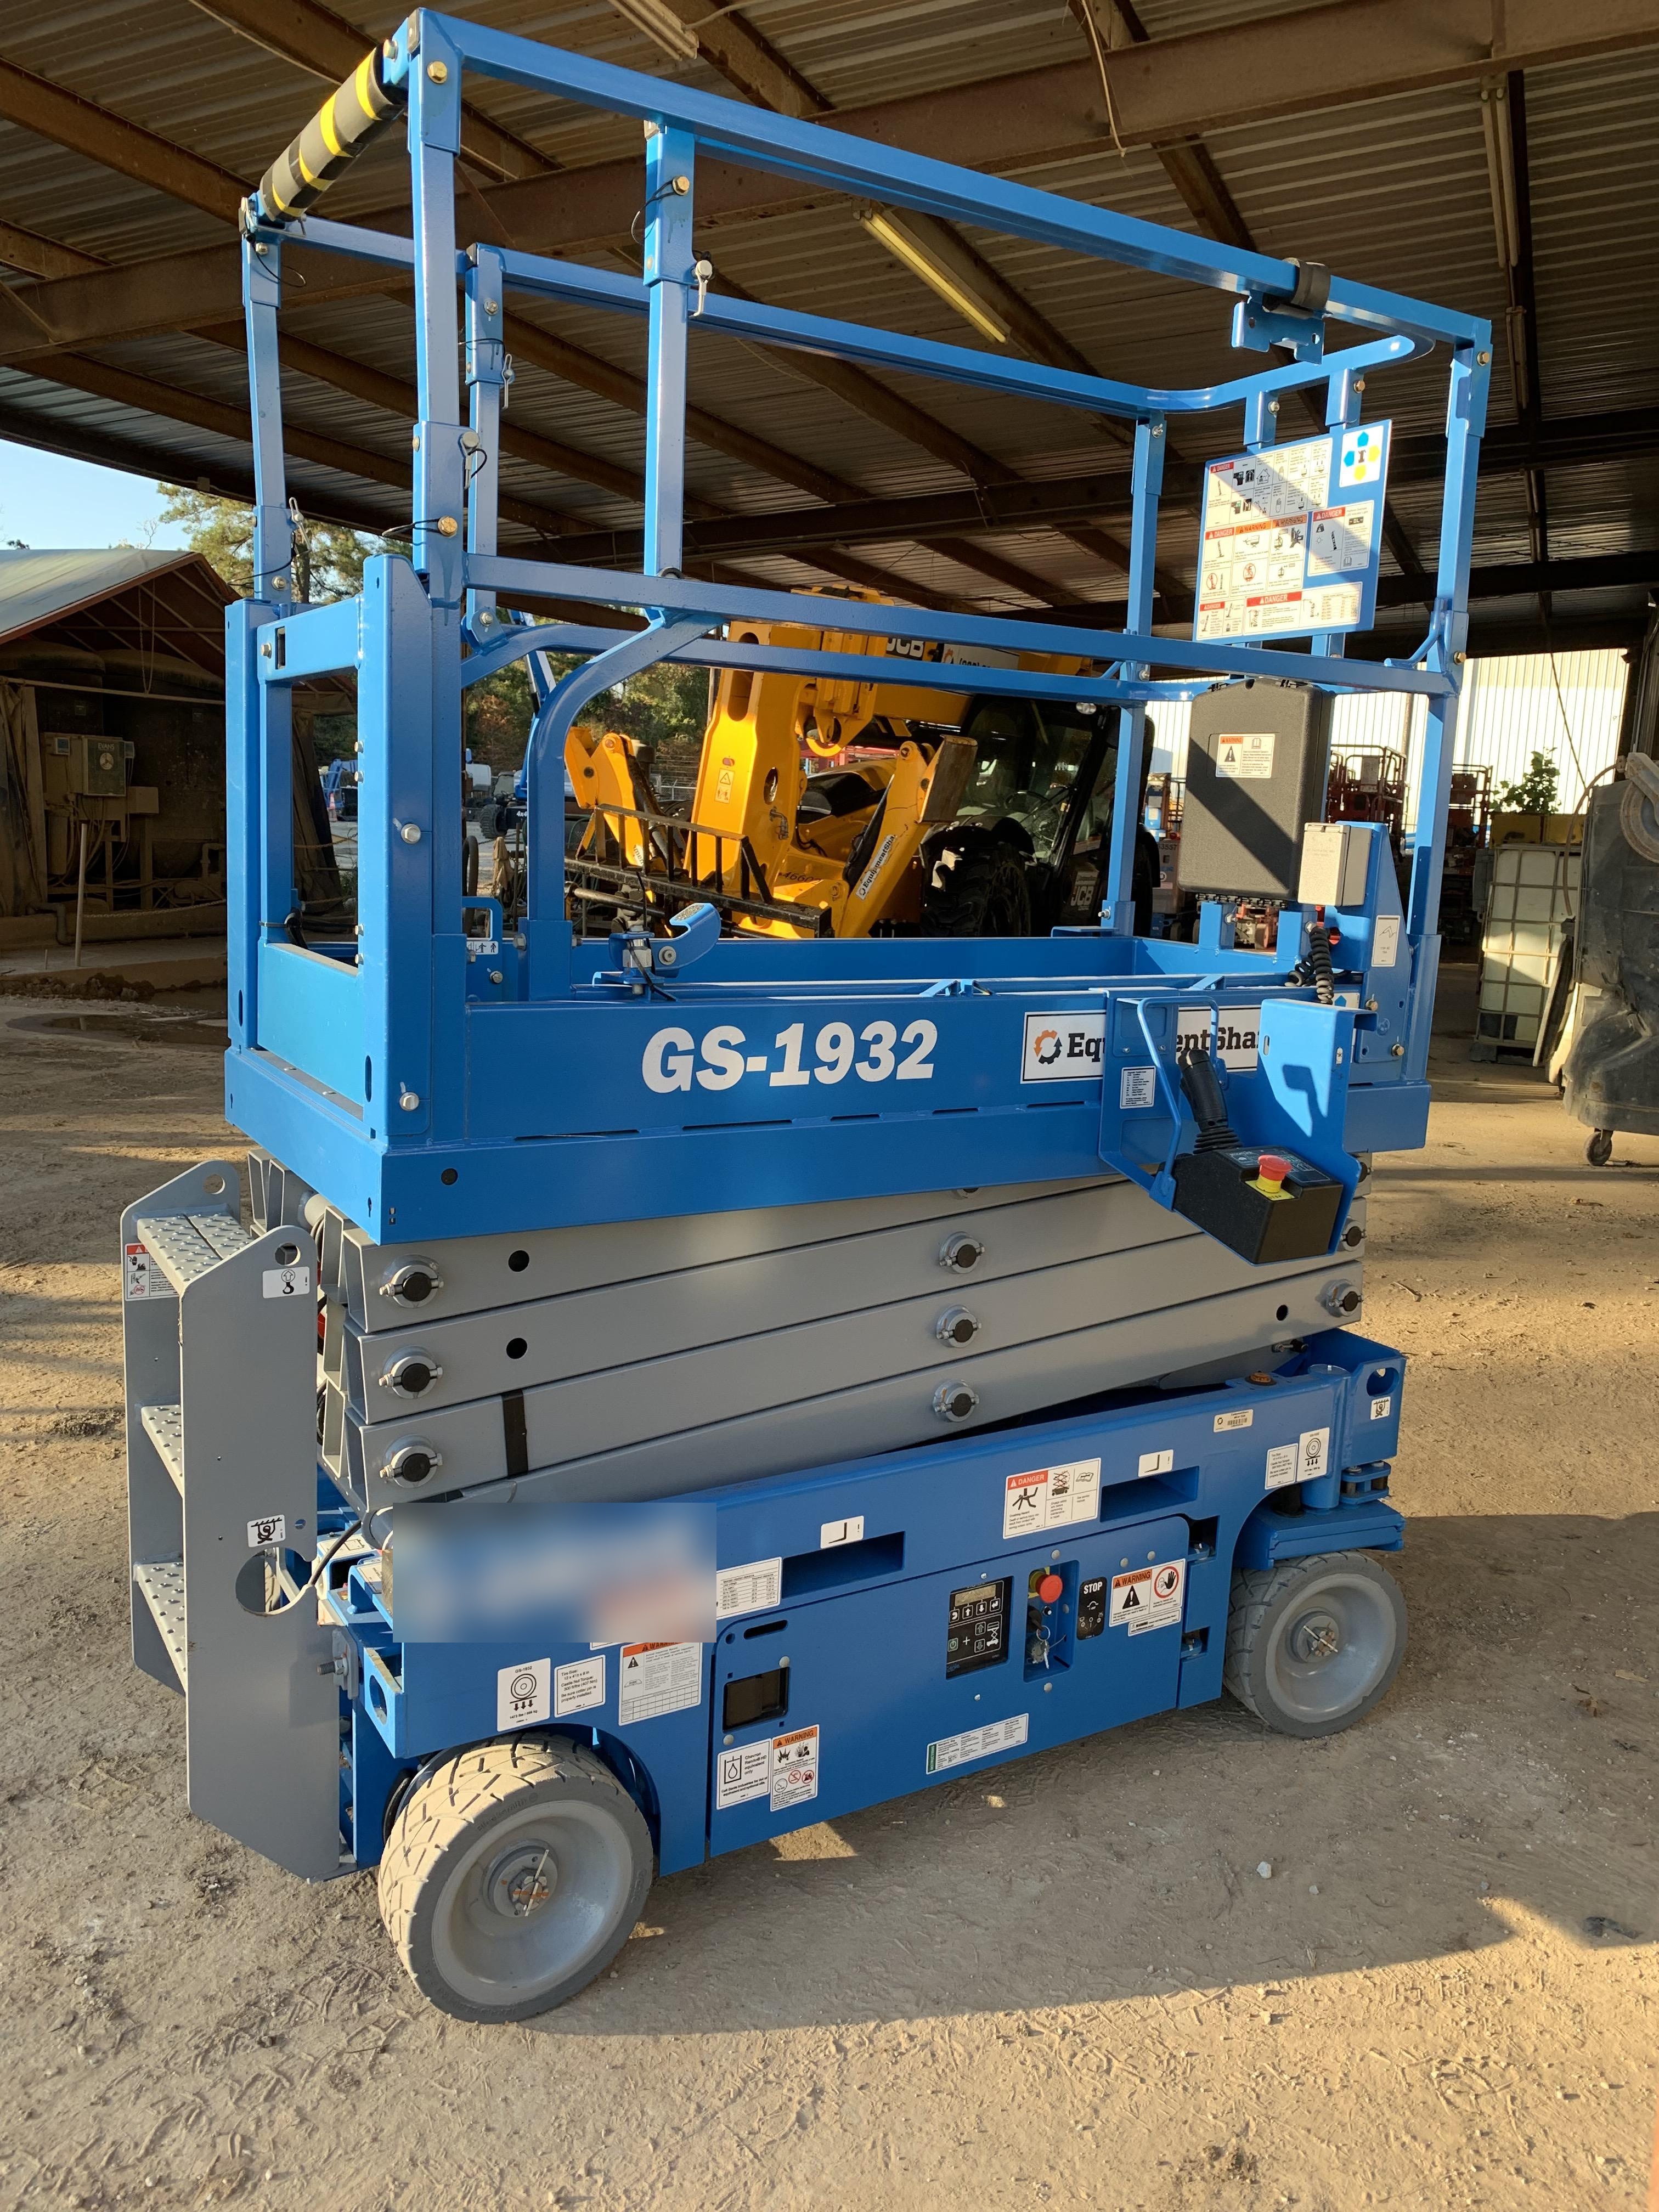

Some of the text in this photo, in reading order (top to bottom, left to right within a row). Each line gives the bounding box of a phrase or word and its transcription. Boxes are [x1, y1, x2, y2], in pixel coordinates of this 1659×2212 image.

[1321, 510, 1342, 519] DANGER
[1280, 516, 1304, 527] WARNING
[1214, 528, 1233, 538] DANGER
[1243, 523, 1266, 533] WARNING
[1264, 594, 1288, 604] DANGER
[887, 637, 924, 658] JCB
[1070, 885, 1094, 906] JCB
[642, 1019, 938, 1093] GS-1932
[1018, 1474, 1045, 1486] DANGER
[1121, 1571, 1151, 1585] WARNING
[1084, 1581, 1103, 1594] STOP
[785, 1730, 814, 1743] WARNING
